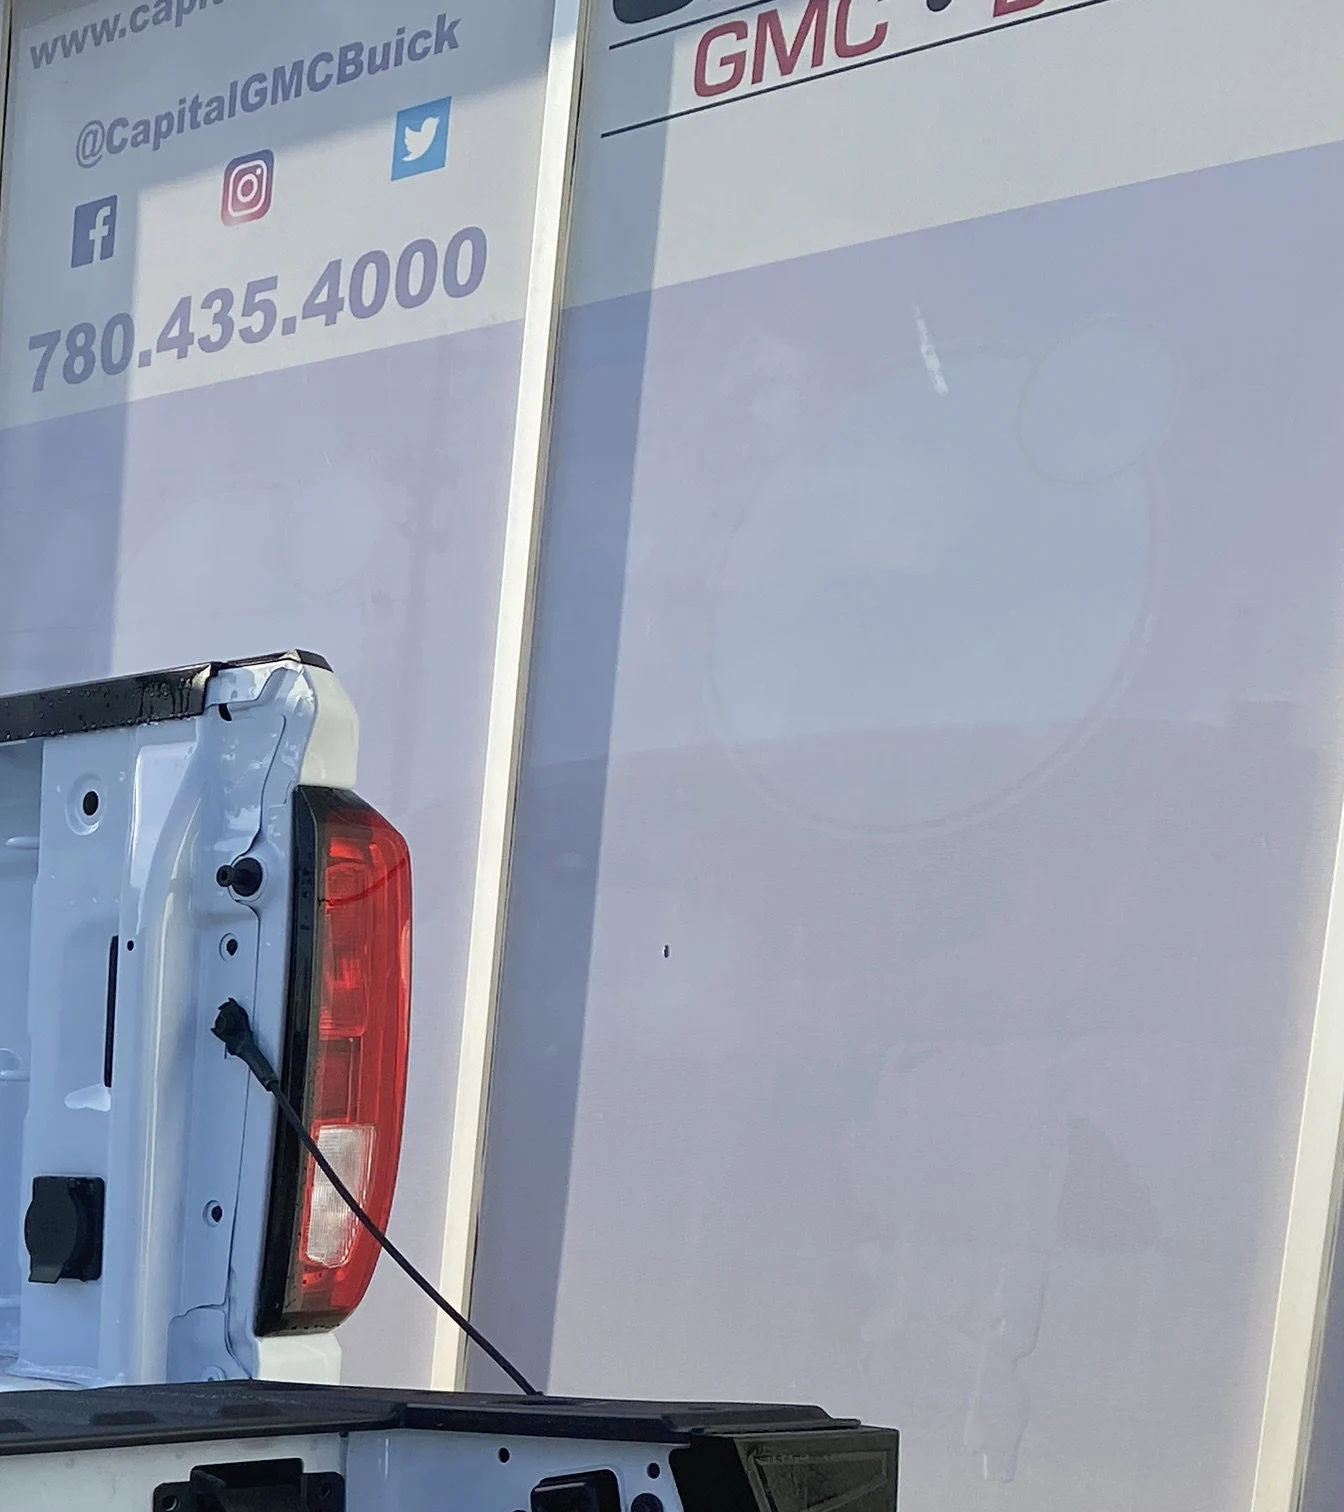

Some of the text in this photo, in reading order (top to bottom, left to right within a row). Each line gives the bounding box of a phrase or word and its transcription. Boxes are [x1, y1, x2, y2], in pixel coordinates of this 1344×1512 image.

[77, 13, 461, 168] @CapitalGMCBuick
[695, 0, 888, 97] GMC
[28, 226, 488, 393] 780.435.4000
